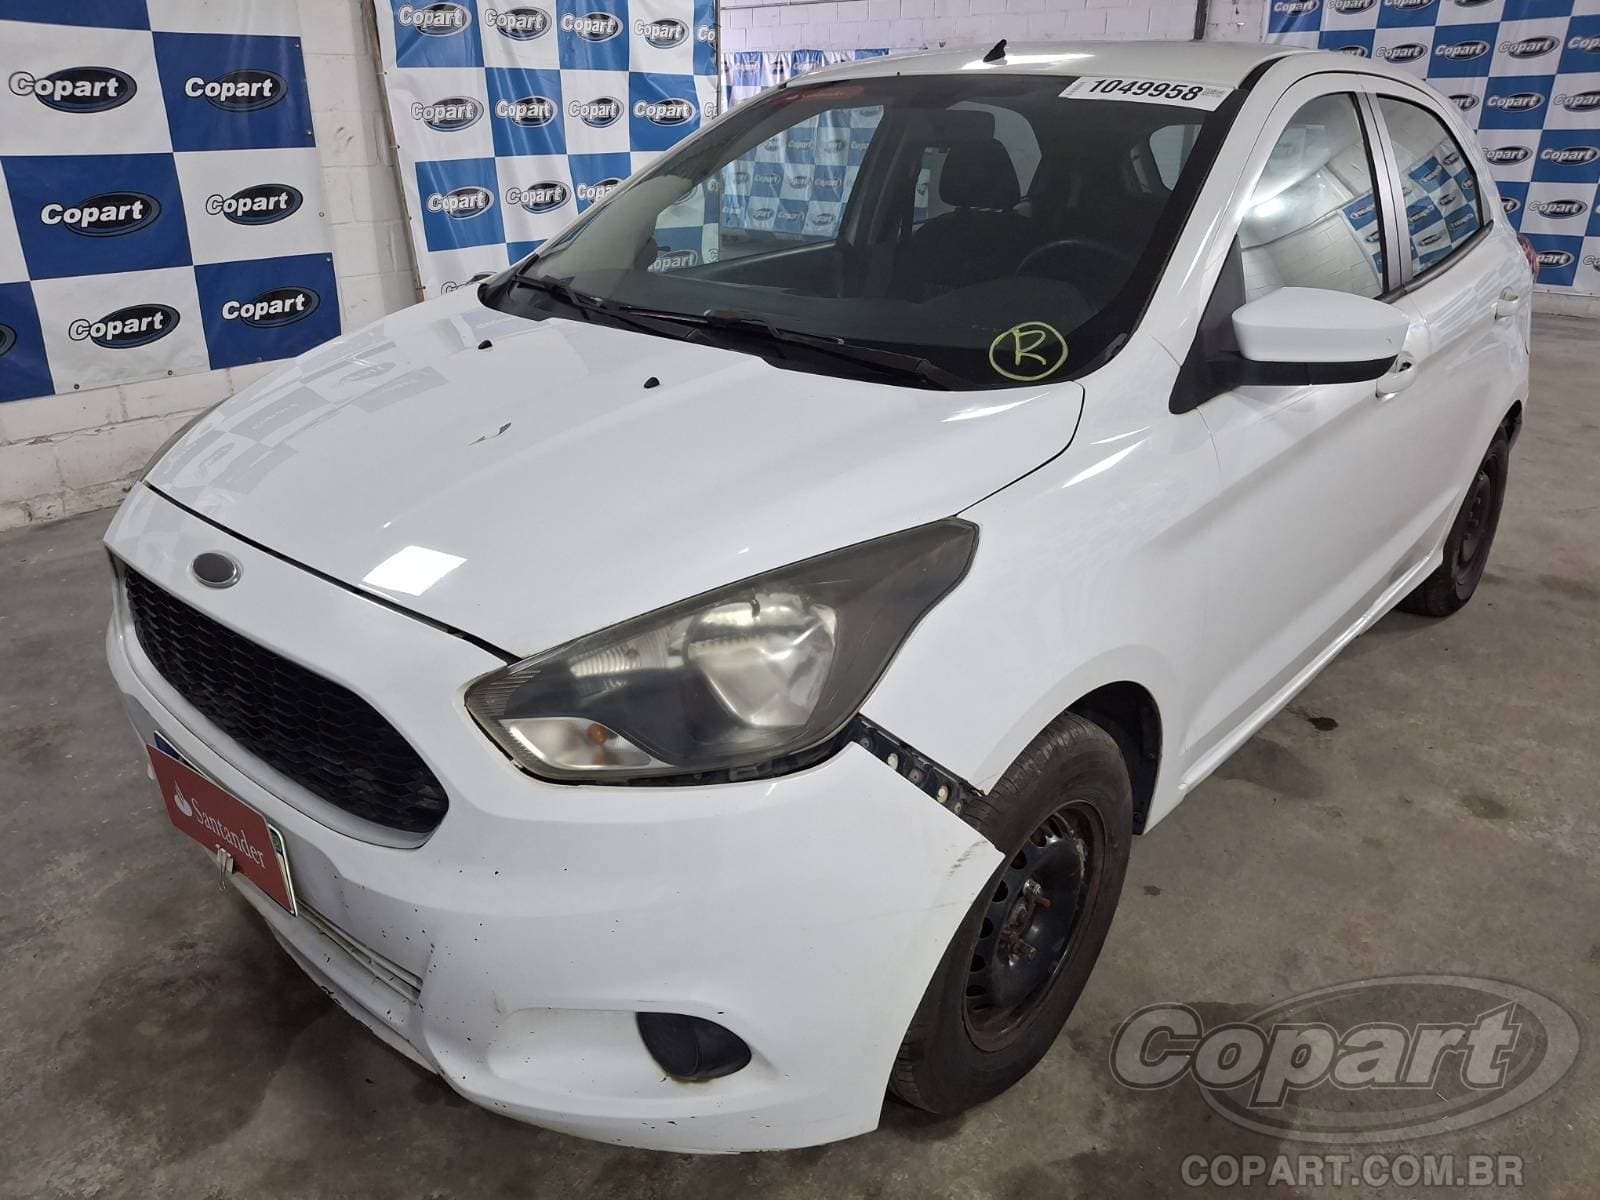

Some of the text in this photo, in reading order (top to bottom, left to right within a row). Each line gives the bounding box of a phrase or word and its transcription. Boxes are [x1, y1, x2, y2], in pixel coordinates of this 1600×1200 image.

[399, 6, 463, 31] Copart
[1274, 1, 1313, 14] Copart
[484, 9, 543, 34] Copart
[560, 13, 614, 36] Copart
[634, 19, 684, 42] Copart
[1376, 47, 1421, 60] Copart
[1435, 41, 1484, 58] Copart
[1500, 40, 1550, 56] Copart
[1568, 35, 1600, 51] Cop
[8, 71, 119, 101] Copart
[184, 77, 273, 101] Copart
[1089, 79, 1203, 101] 1049958
[496, 100, 550, 121] Copart
[568, 100, 619, 122] Copart
[633, 99, 692, 121] Copart
[1487, 95, 1537, 108] Copart
[411, 101, 475, 125] Copart
[1541, 148, 1593, 162] Copart
[206, 190, 289, 217] Copart
[427, 191, 486, 214] Copart
[506, 186, 563, 208] Copart
[1529, 200, 1579, 215] Copart
[40, 198, 144, 228] Copart
[1538, 252, 1567, 264] part
[221, 293, 305, 320] Copart
[68, 310, 164, 342] Copart
[1013, 327, 1046, 366] R
[191, 798, 266, 869] Santander
